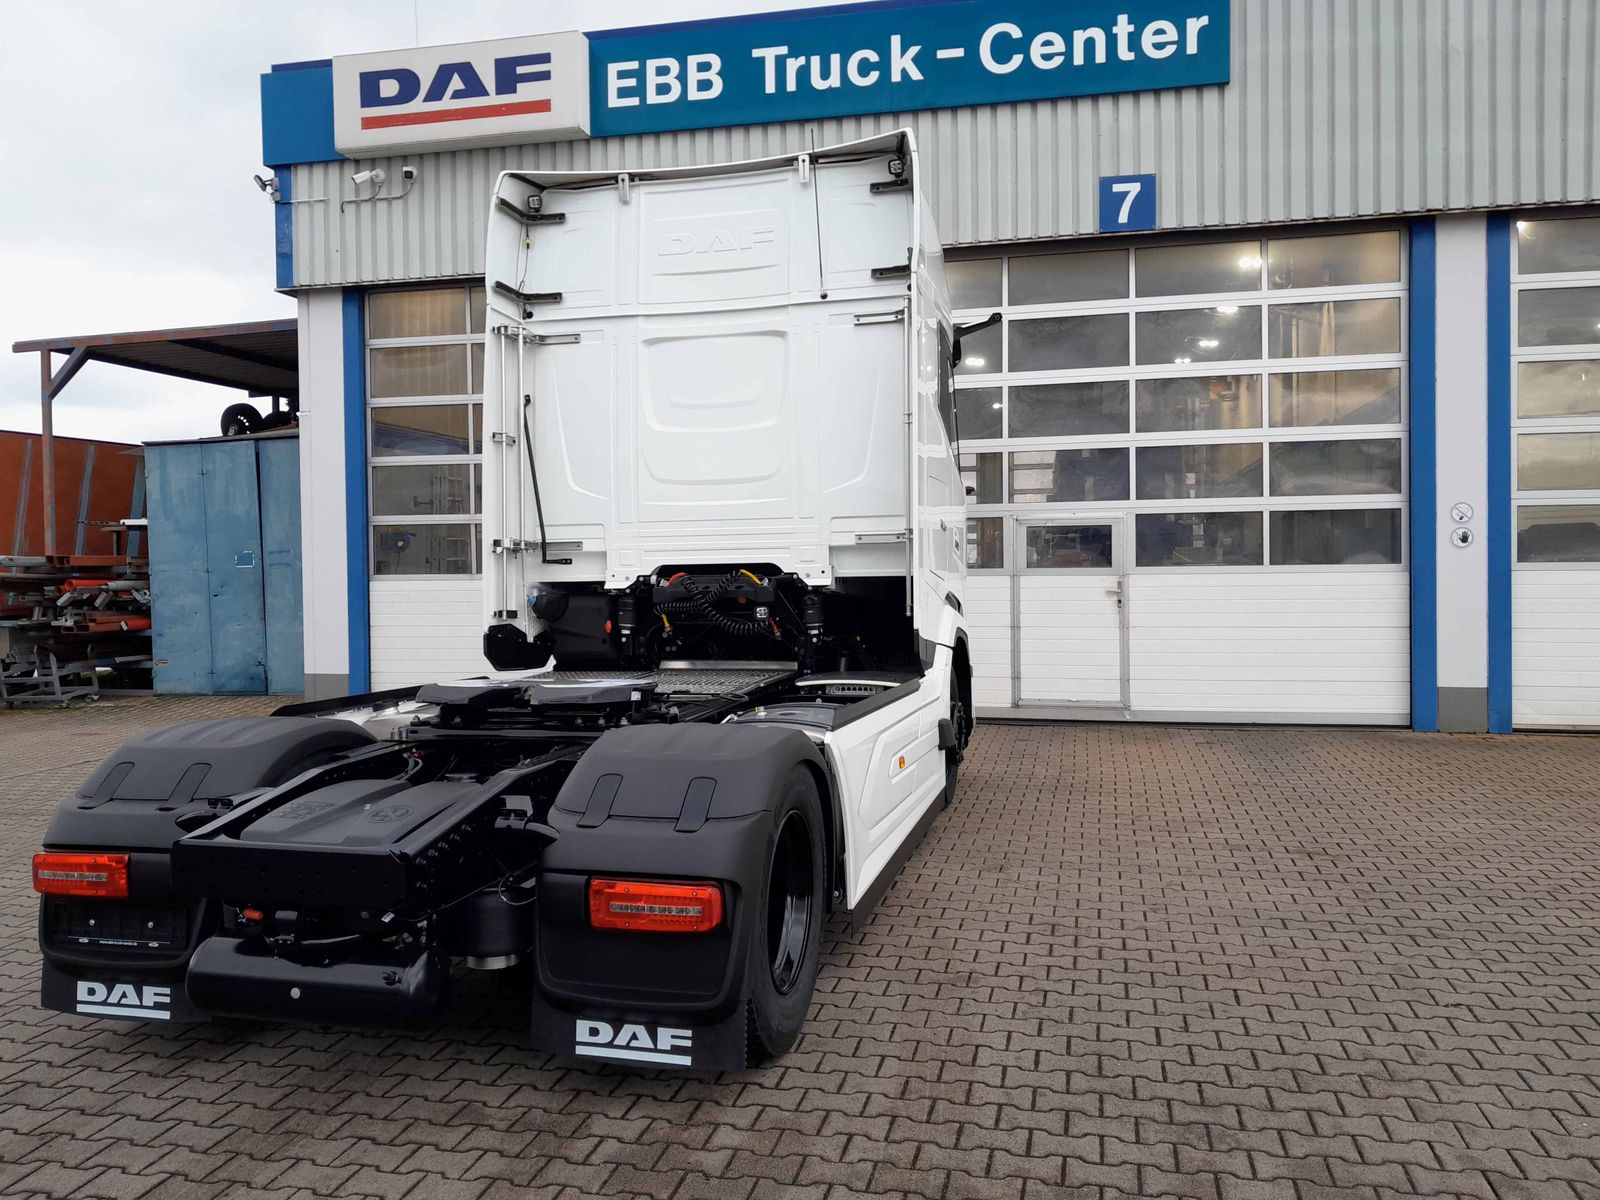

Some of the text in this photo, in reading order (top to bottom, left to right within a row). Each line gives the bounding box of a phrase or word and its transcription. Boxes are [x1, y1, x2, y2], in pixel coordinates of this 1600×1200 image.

[607, 53, 724, 108] EBB
[751, 34, 925, 94] Truck
[979, 13, 1209, 75] Center
[359, 52, 552, 109] DAF
[1112, 182, 1141, 224] 7
[657, 225, 775, 257] DAF
[76, 980, 171, 1007] DAF
[575, 1019, 693, 1051] DAF
